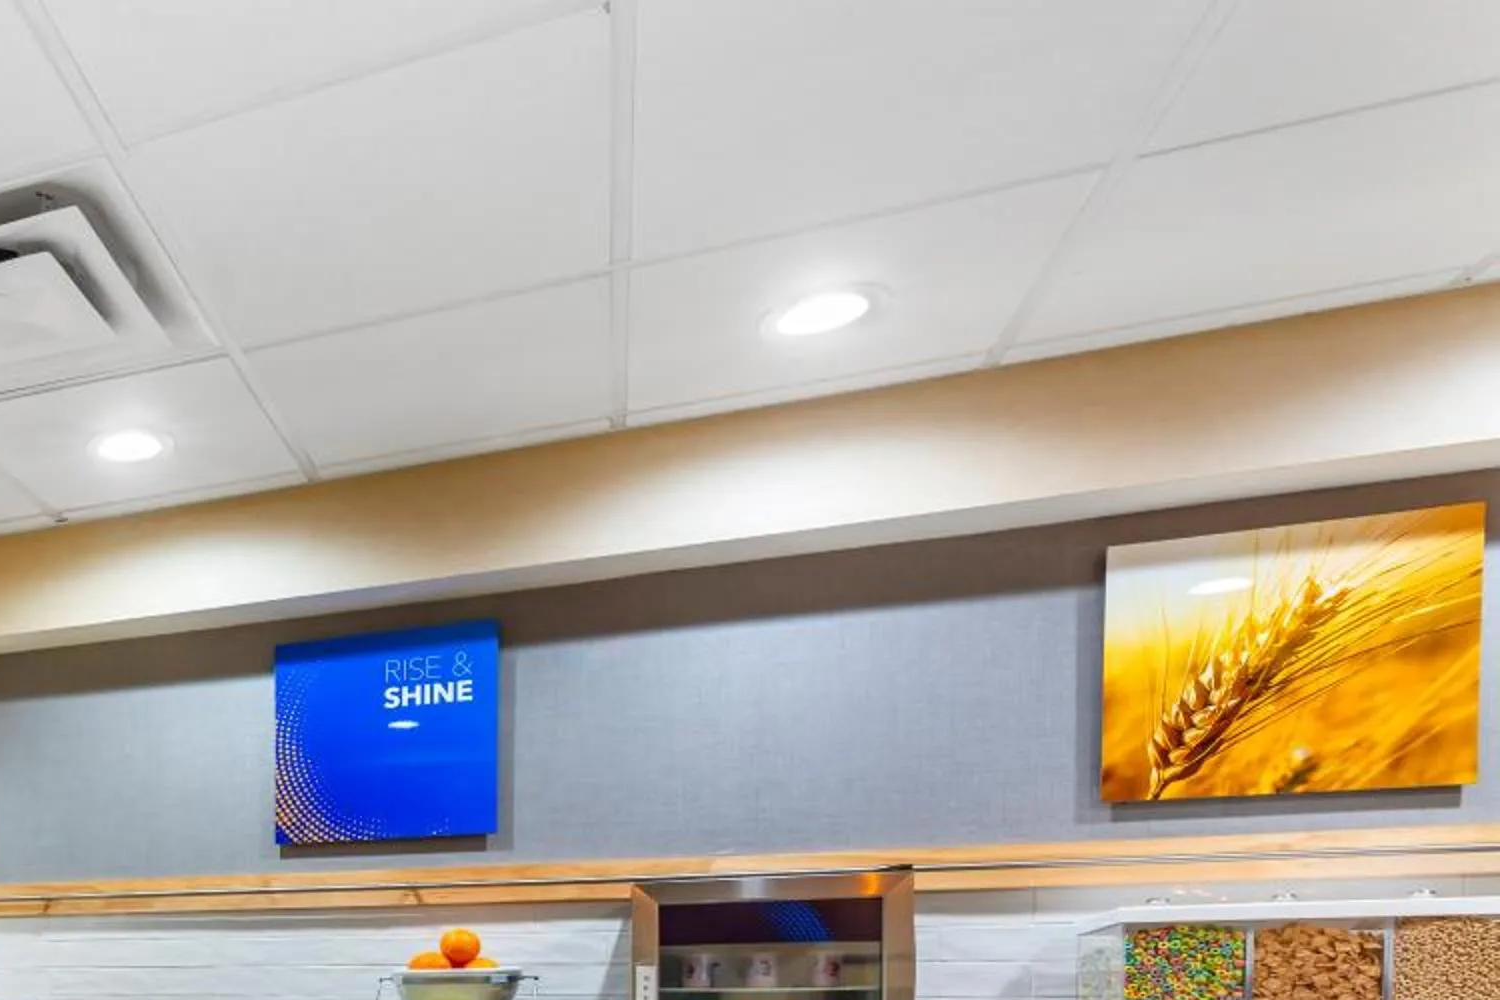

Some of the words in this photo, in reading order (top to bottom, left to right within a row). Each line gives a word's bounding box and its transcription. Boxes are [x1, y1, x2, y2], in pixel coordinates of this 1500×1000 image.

[385, 656, 442, 683] RISE
[452, 651, 472, 676] &
[384, 680, 473, 709] SHINE
